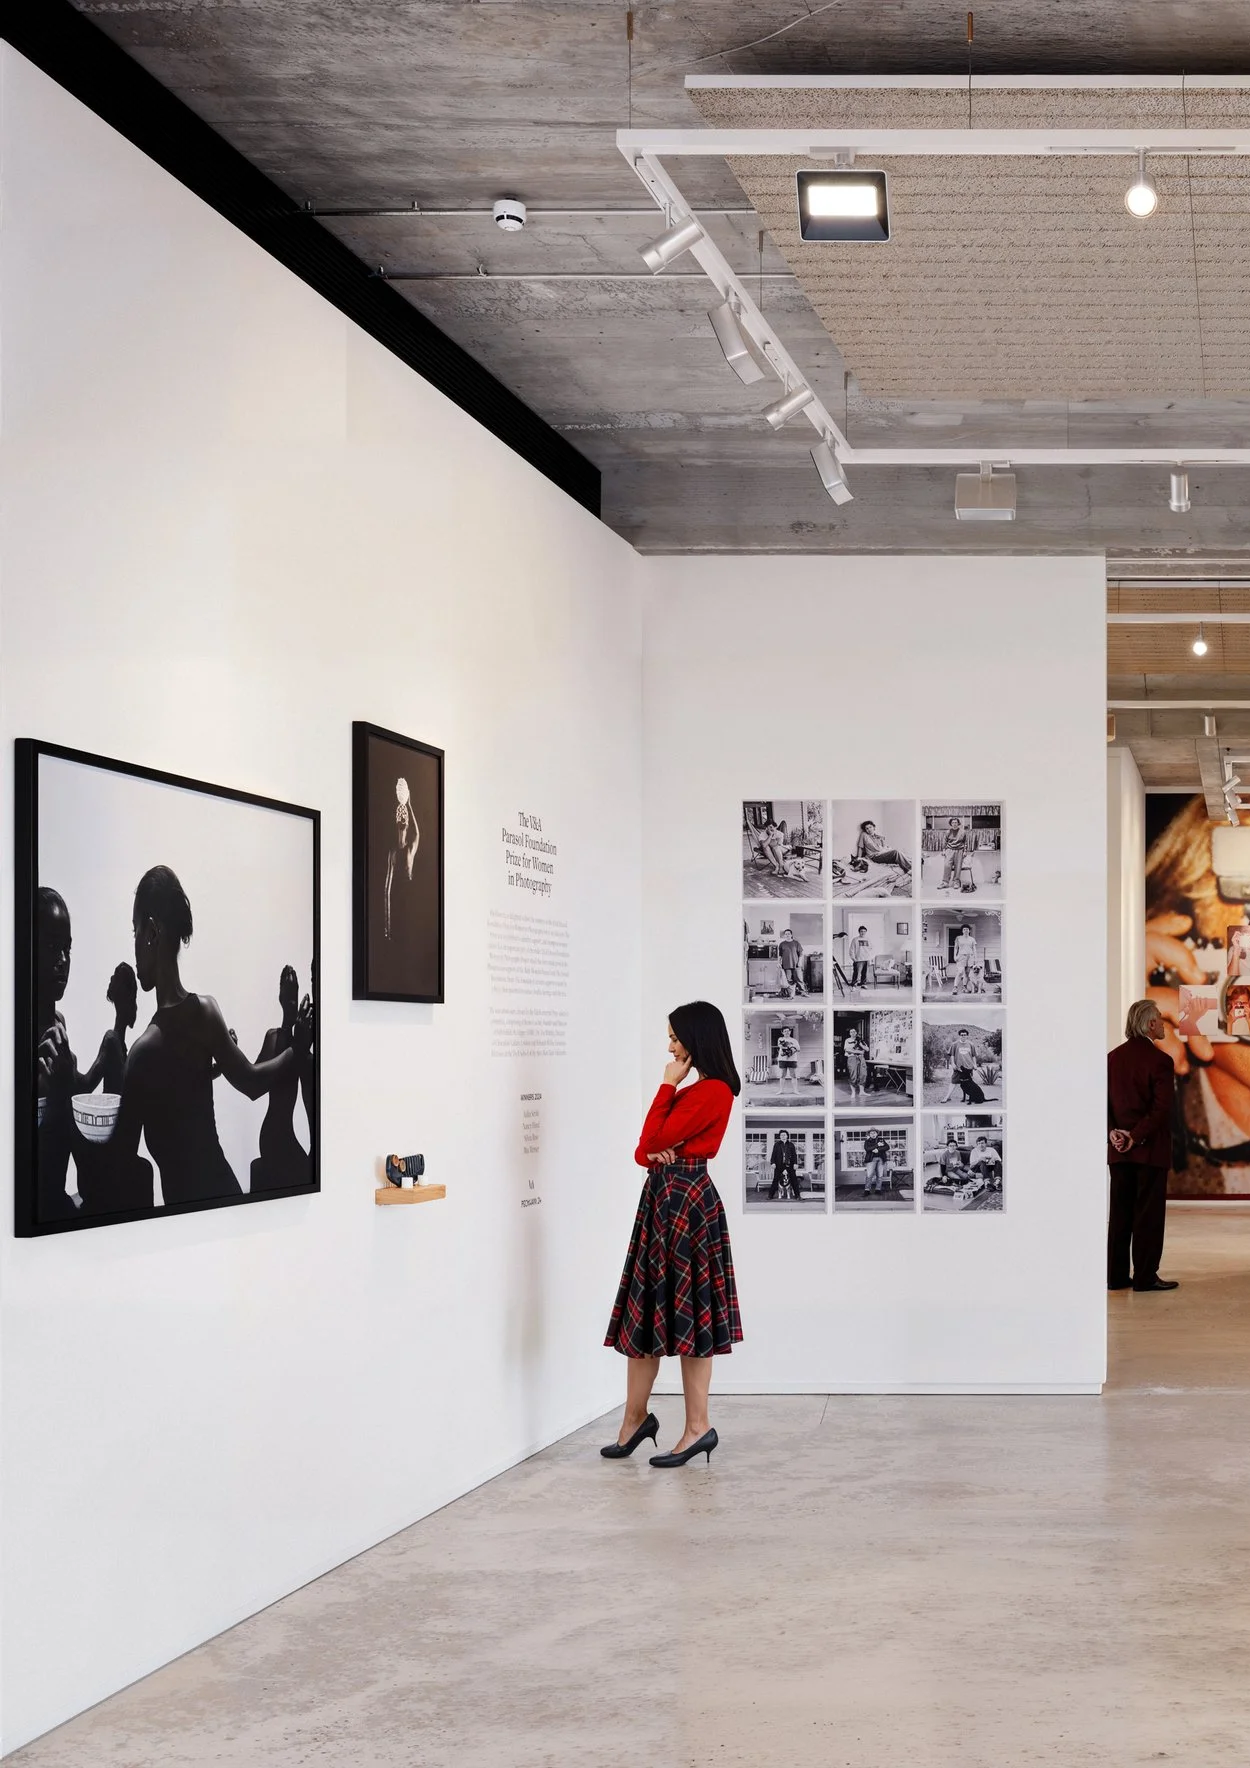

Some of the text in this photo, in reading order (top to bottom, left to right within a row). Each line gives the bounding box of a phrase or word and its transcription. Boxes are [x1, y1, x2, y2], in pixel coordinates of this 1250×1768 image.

[518, 811, 542, 832] The V&A
[502, 828, 557, 856] Parasol Foundation
[505, 849, 554, 874] Prize for Women
[508, 870, 552, 898] in Photography
